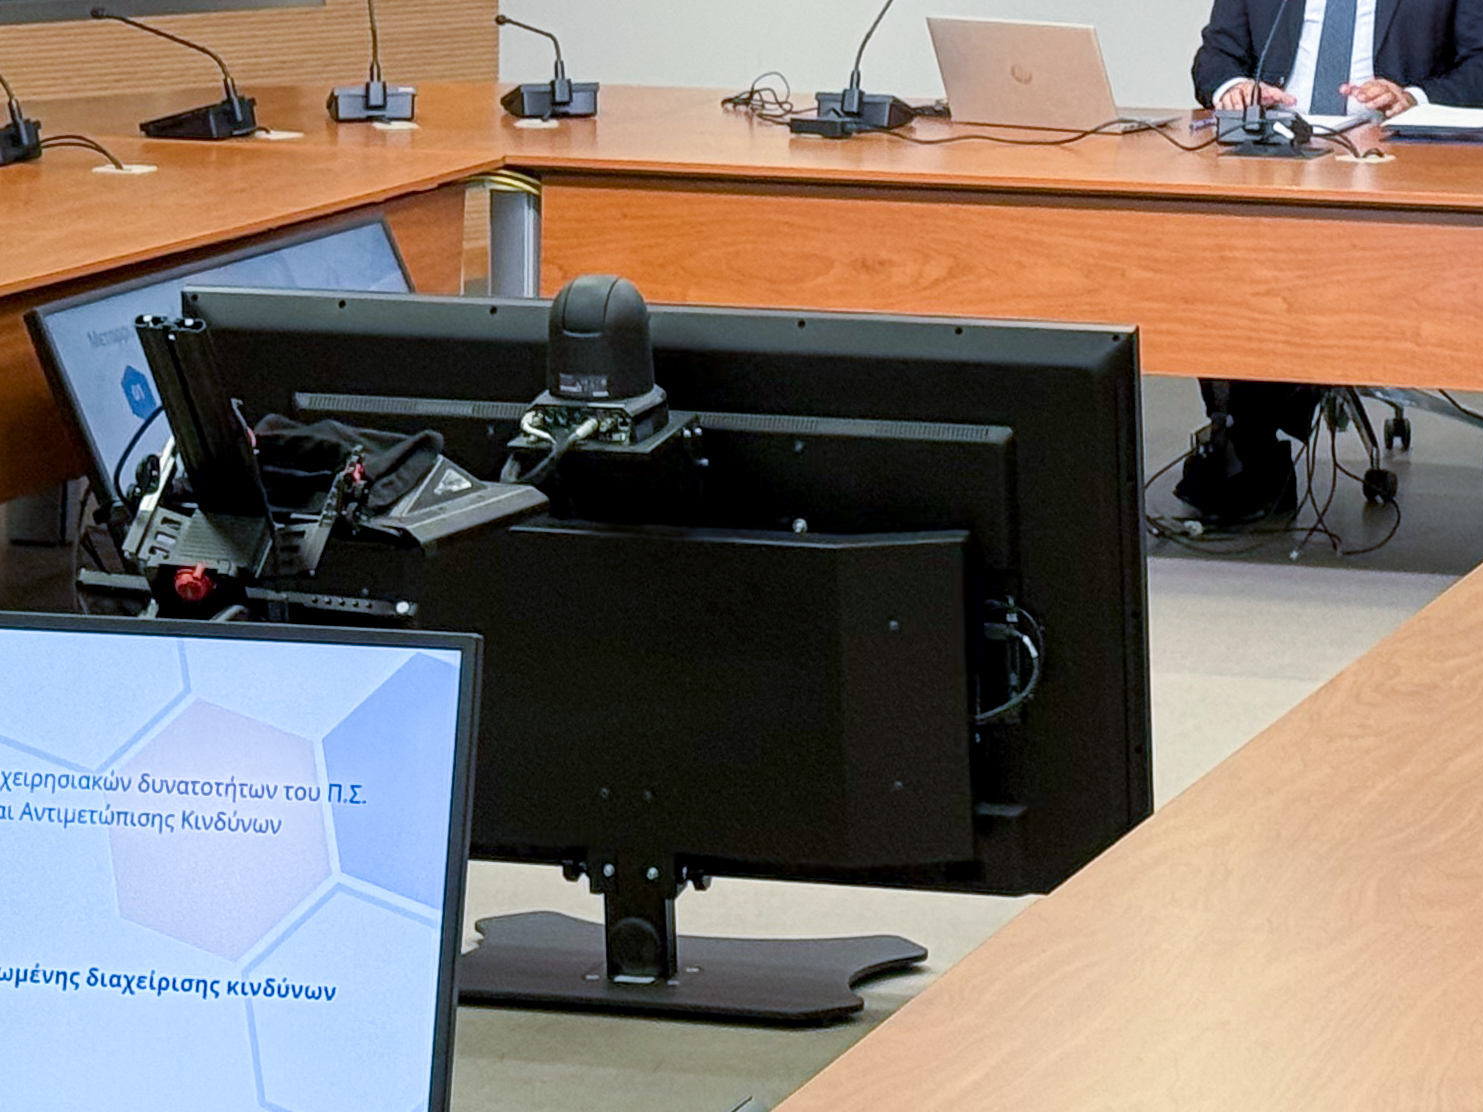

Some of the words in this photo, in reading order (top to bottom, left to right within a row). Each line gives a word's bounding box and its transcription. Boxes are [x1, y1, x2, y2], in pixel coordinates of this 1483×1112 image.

[138, 773, 278, 804] δυνατοτήτων
[284, 784, 320, 802] του
[327, 783, 368, 805] Π.Σ.
[18, 801, 176, 834] Αντιμετώπισης
[181, 809, 282, 835] Κινδύνων
[86, 967, 221, 1000] διαχείρισης
[226, 976, 337, 1002] κινδύνων
